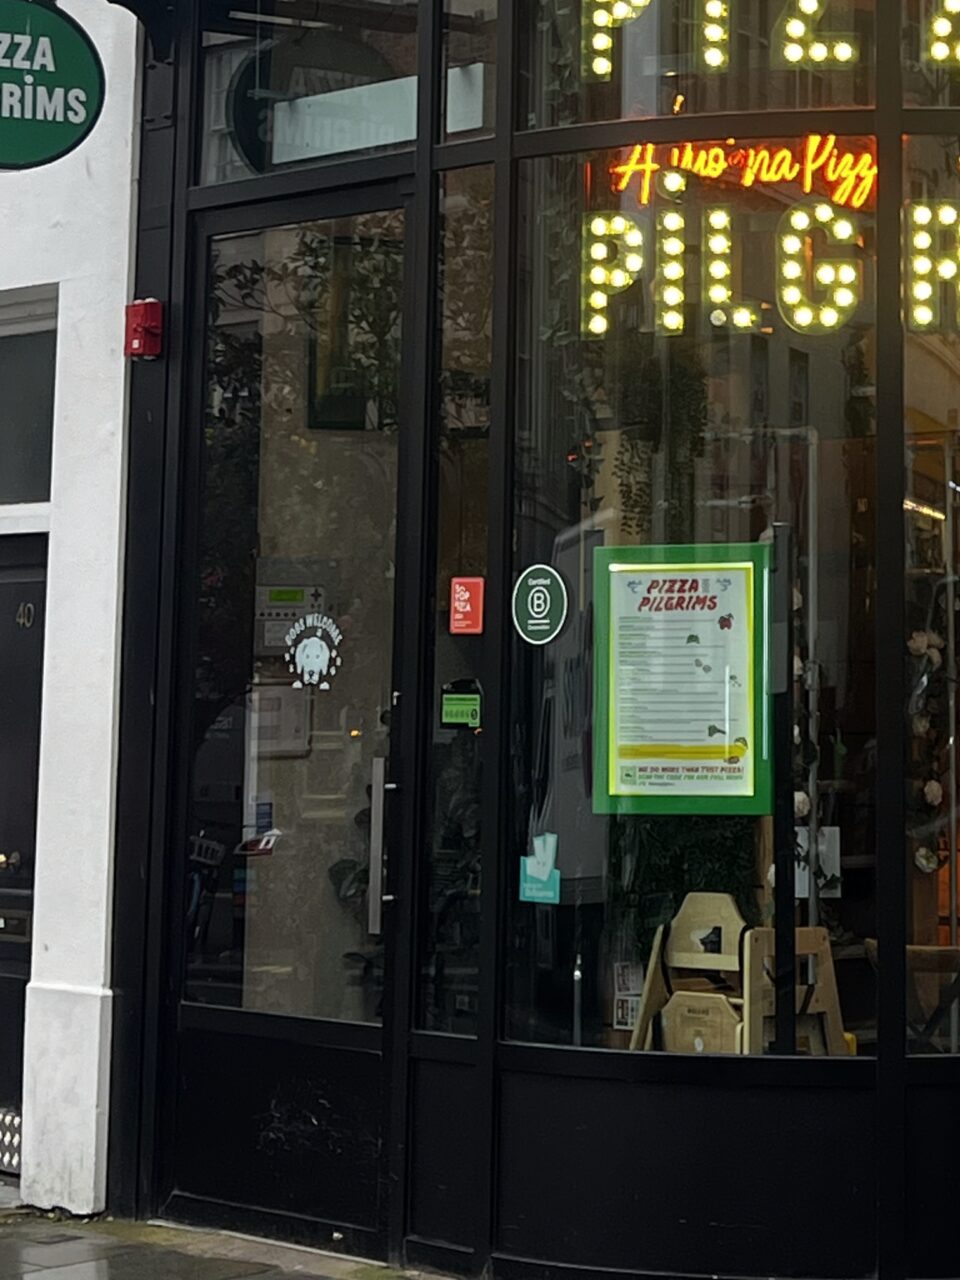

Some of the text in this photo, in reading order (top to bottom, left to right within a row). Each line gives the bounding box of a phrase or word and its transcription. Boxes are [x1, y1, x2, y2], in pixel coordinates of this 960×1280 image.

[646, 579, 700, 595] PIZZA
[637, 595, 718, 612] PILGRIMS
[15, 602, 35, 628] 40
